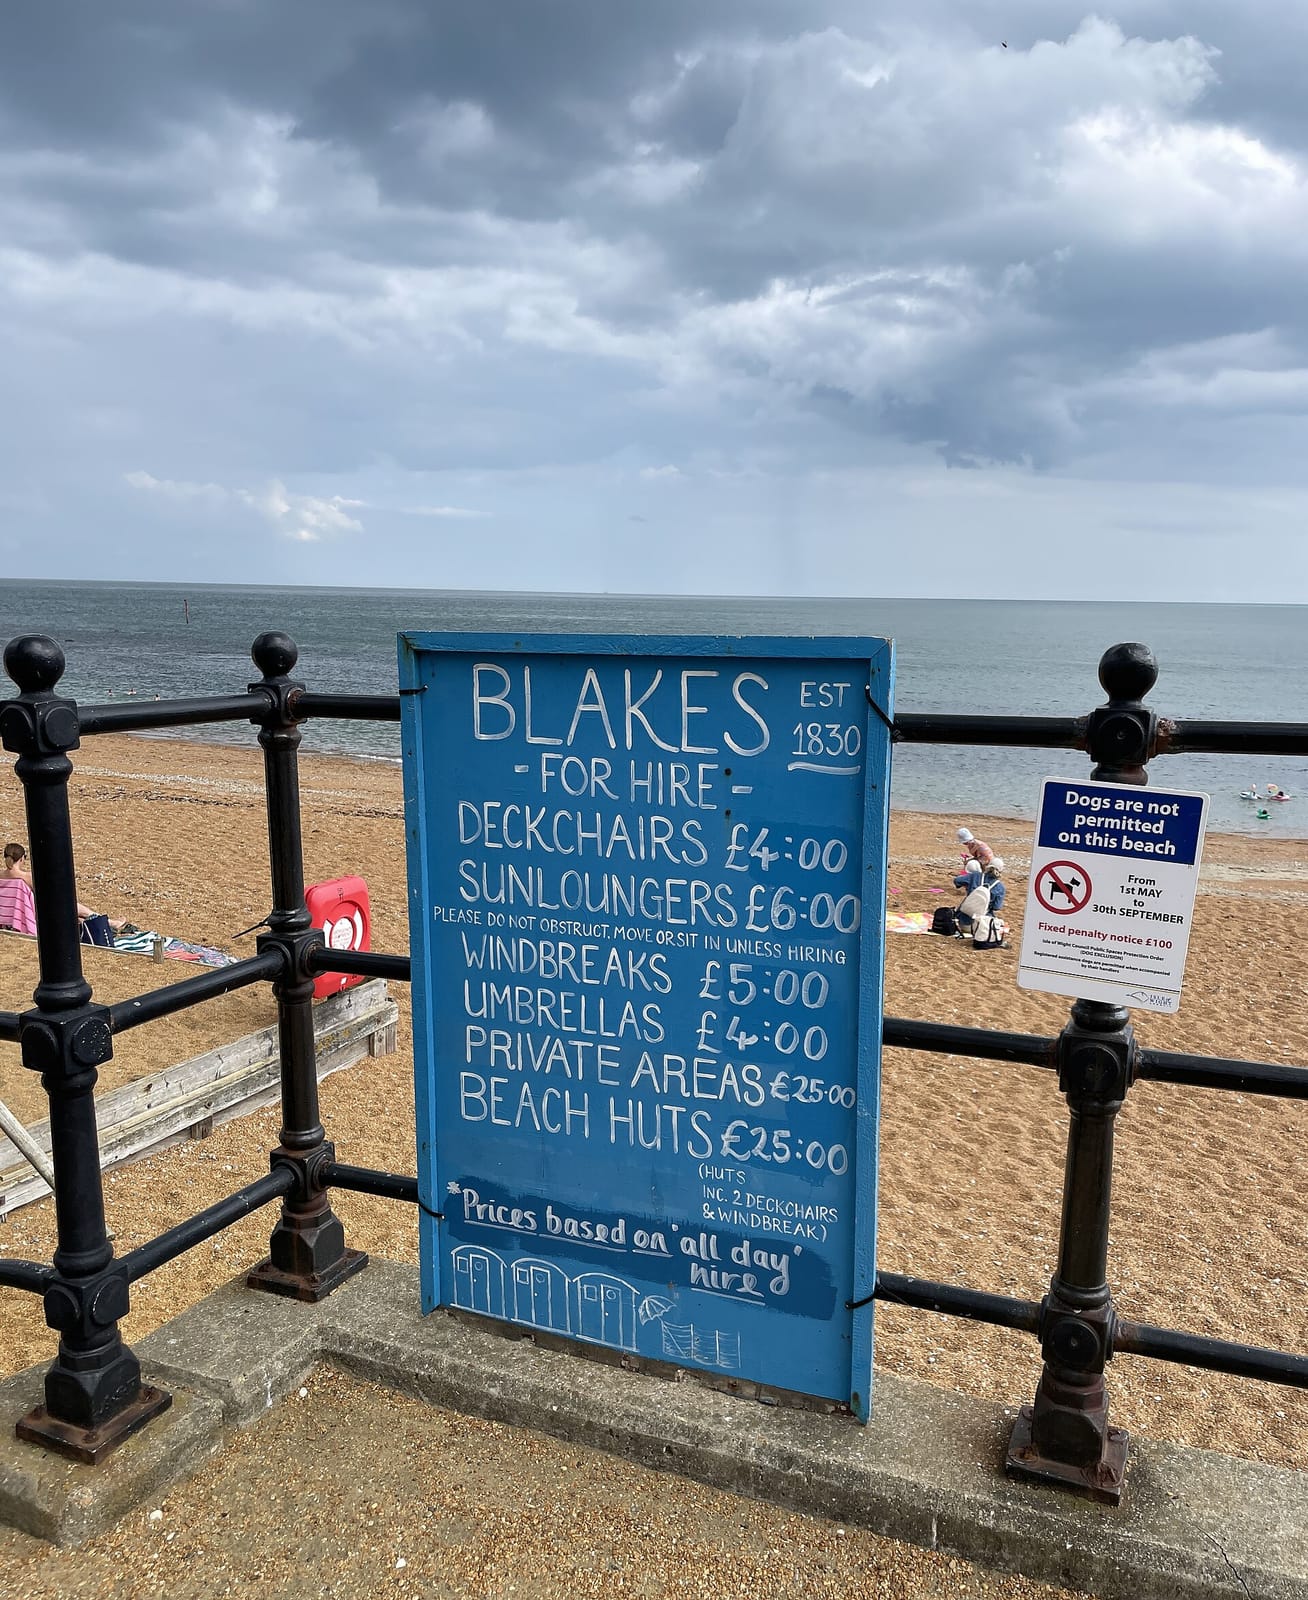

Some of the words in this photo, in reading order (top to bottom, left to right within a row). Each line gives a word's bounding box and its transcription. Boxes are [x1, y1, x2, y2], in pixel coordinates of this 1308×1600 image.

[472, 663, 770, 757] BLAKES
[801, 682, 851, 708] EST
[792, 722, 862, 757] 1830
[541, 753, 619, 800] FOR
[630, 760, 719, 810] HIRE
[1065, 791, 1111, 811] Dogs
[1114, 799, 1143, 812] are
[1148, 801, 1179, 817] not
[459, 800, 709, 867] DECKCHAIRS
[724, 823, 848, 873] £4:00
[1074, 813, 1165, 835] permitted
[1058, 831, 1080, 844] on
[1085, 832, 1118, 848] this
[1121, 836, 1176, 856] beach
[459, 859, 738, 930] SUNLOUNGERS
[745, 884, 861, 934] £6:00
[1119, 885, 1135, 895] 1st
[1137, 888, 1163, 899] MAY
[1128, 874, 1156, 886] From
[1092, 904, 1117, 916] 30th
[1119, 908, 1184, 925] SEPTEMBER
[1133, 899, 1145, 908] to
[434, 906, 482, 926] PLEASE
[487, 912, 505, 927] DO
[509, 915, 537, 931] NOT
[613, 926, 653, 943] MOVE
[704, 936, 720, 950] IN
[726, 938, 782, 959] UNLESS
[788, 944, 847, 965] HIRING
[1038, 922, 1066, 934] Fixed
[1067, 927, 1108, 941] penalty
[1110, 933, 1143, 945] notice
[1145, 938, 1173, 949] £100
[461, 931, 673, 994] WINDBREAKS
[699, 960, 829, 1009] £5:00
[1123, 951, 1149, 959] Protection
[464, 979, 666, 1044] UMBRELLAS
[696, 1010, 828, 1061] £4:00
[466, 1025, 621, 1086] PRIVATE
[630, 1051, 766, 1107] AREAS
[459, 1071, 590, 1138] BEACH
[610, 1096, 713, 1160] HUTS
[720, 1120, 848, 1176] £25:00
[698, 1162, 746, 1185] (HUTS
[703, 1185, 728, 1202] INC.
[732, 1190, 743, 1206] 2
[746, 1192, 839, 1224] DECKCHAIRS
[546, 1205, 626, 1245] based
[633, 1229, 670, 1254] on
[702, 1203, 715, 1220] &
[718, 1207, 828, 1243] WINDBREAK)
[690, 1262, 765, 1298] hire
